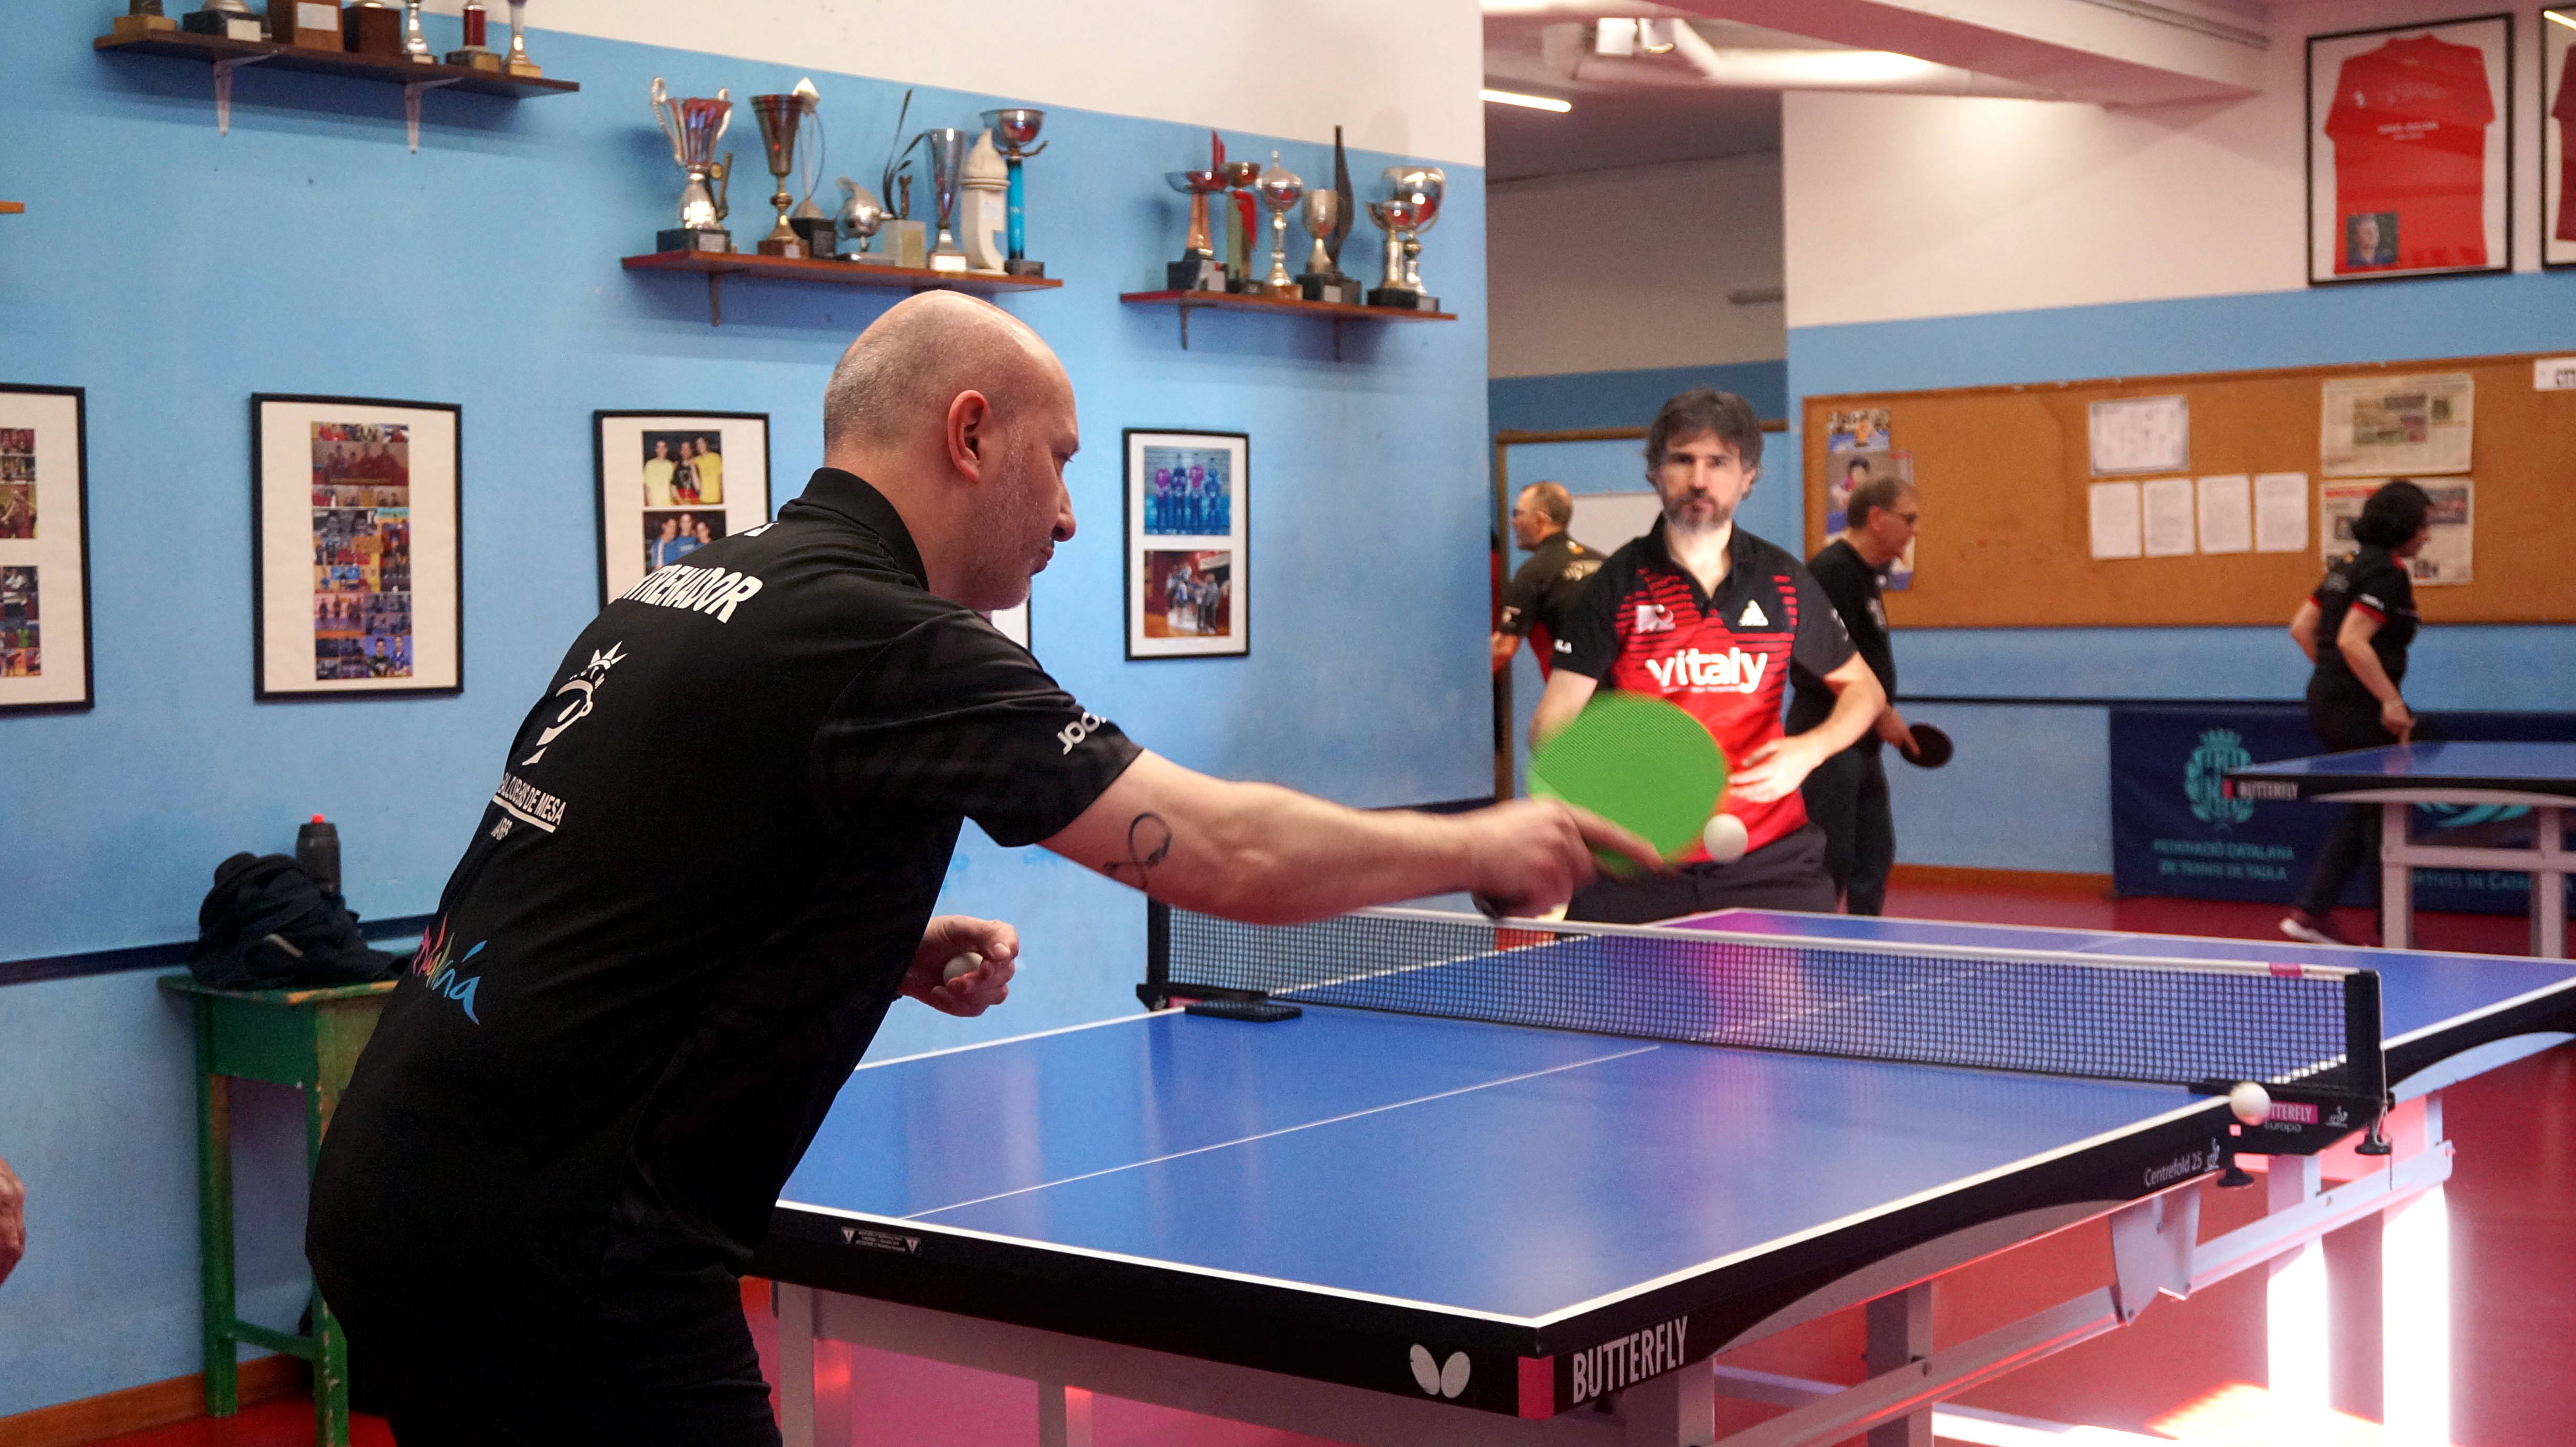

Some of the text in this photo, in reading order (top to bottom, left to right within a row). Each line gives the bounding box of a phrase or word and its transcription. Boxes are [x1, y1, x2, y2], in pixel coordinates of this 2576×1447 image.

[1645, 647, 1768, 694] vitaly
[1057, 711, 1107, 755] JOO
[523, 787, 541, 813] DE
[534, 793, 566, 825] MESA
[2265, 1118, 2302, 1133] Europa
[2271, 1103, 2312, 1122] TTERFLY
[2144, 1154, 2190, 1187] Centrefold
[2191, 1150, 2203, 1171] 25
[1573, 1316, 1688, 1403] BUTTERFLY
